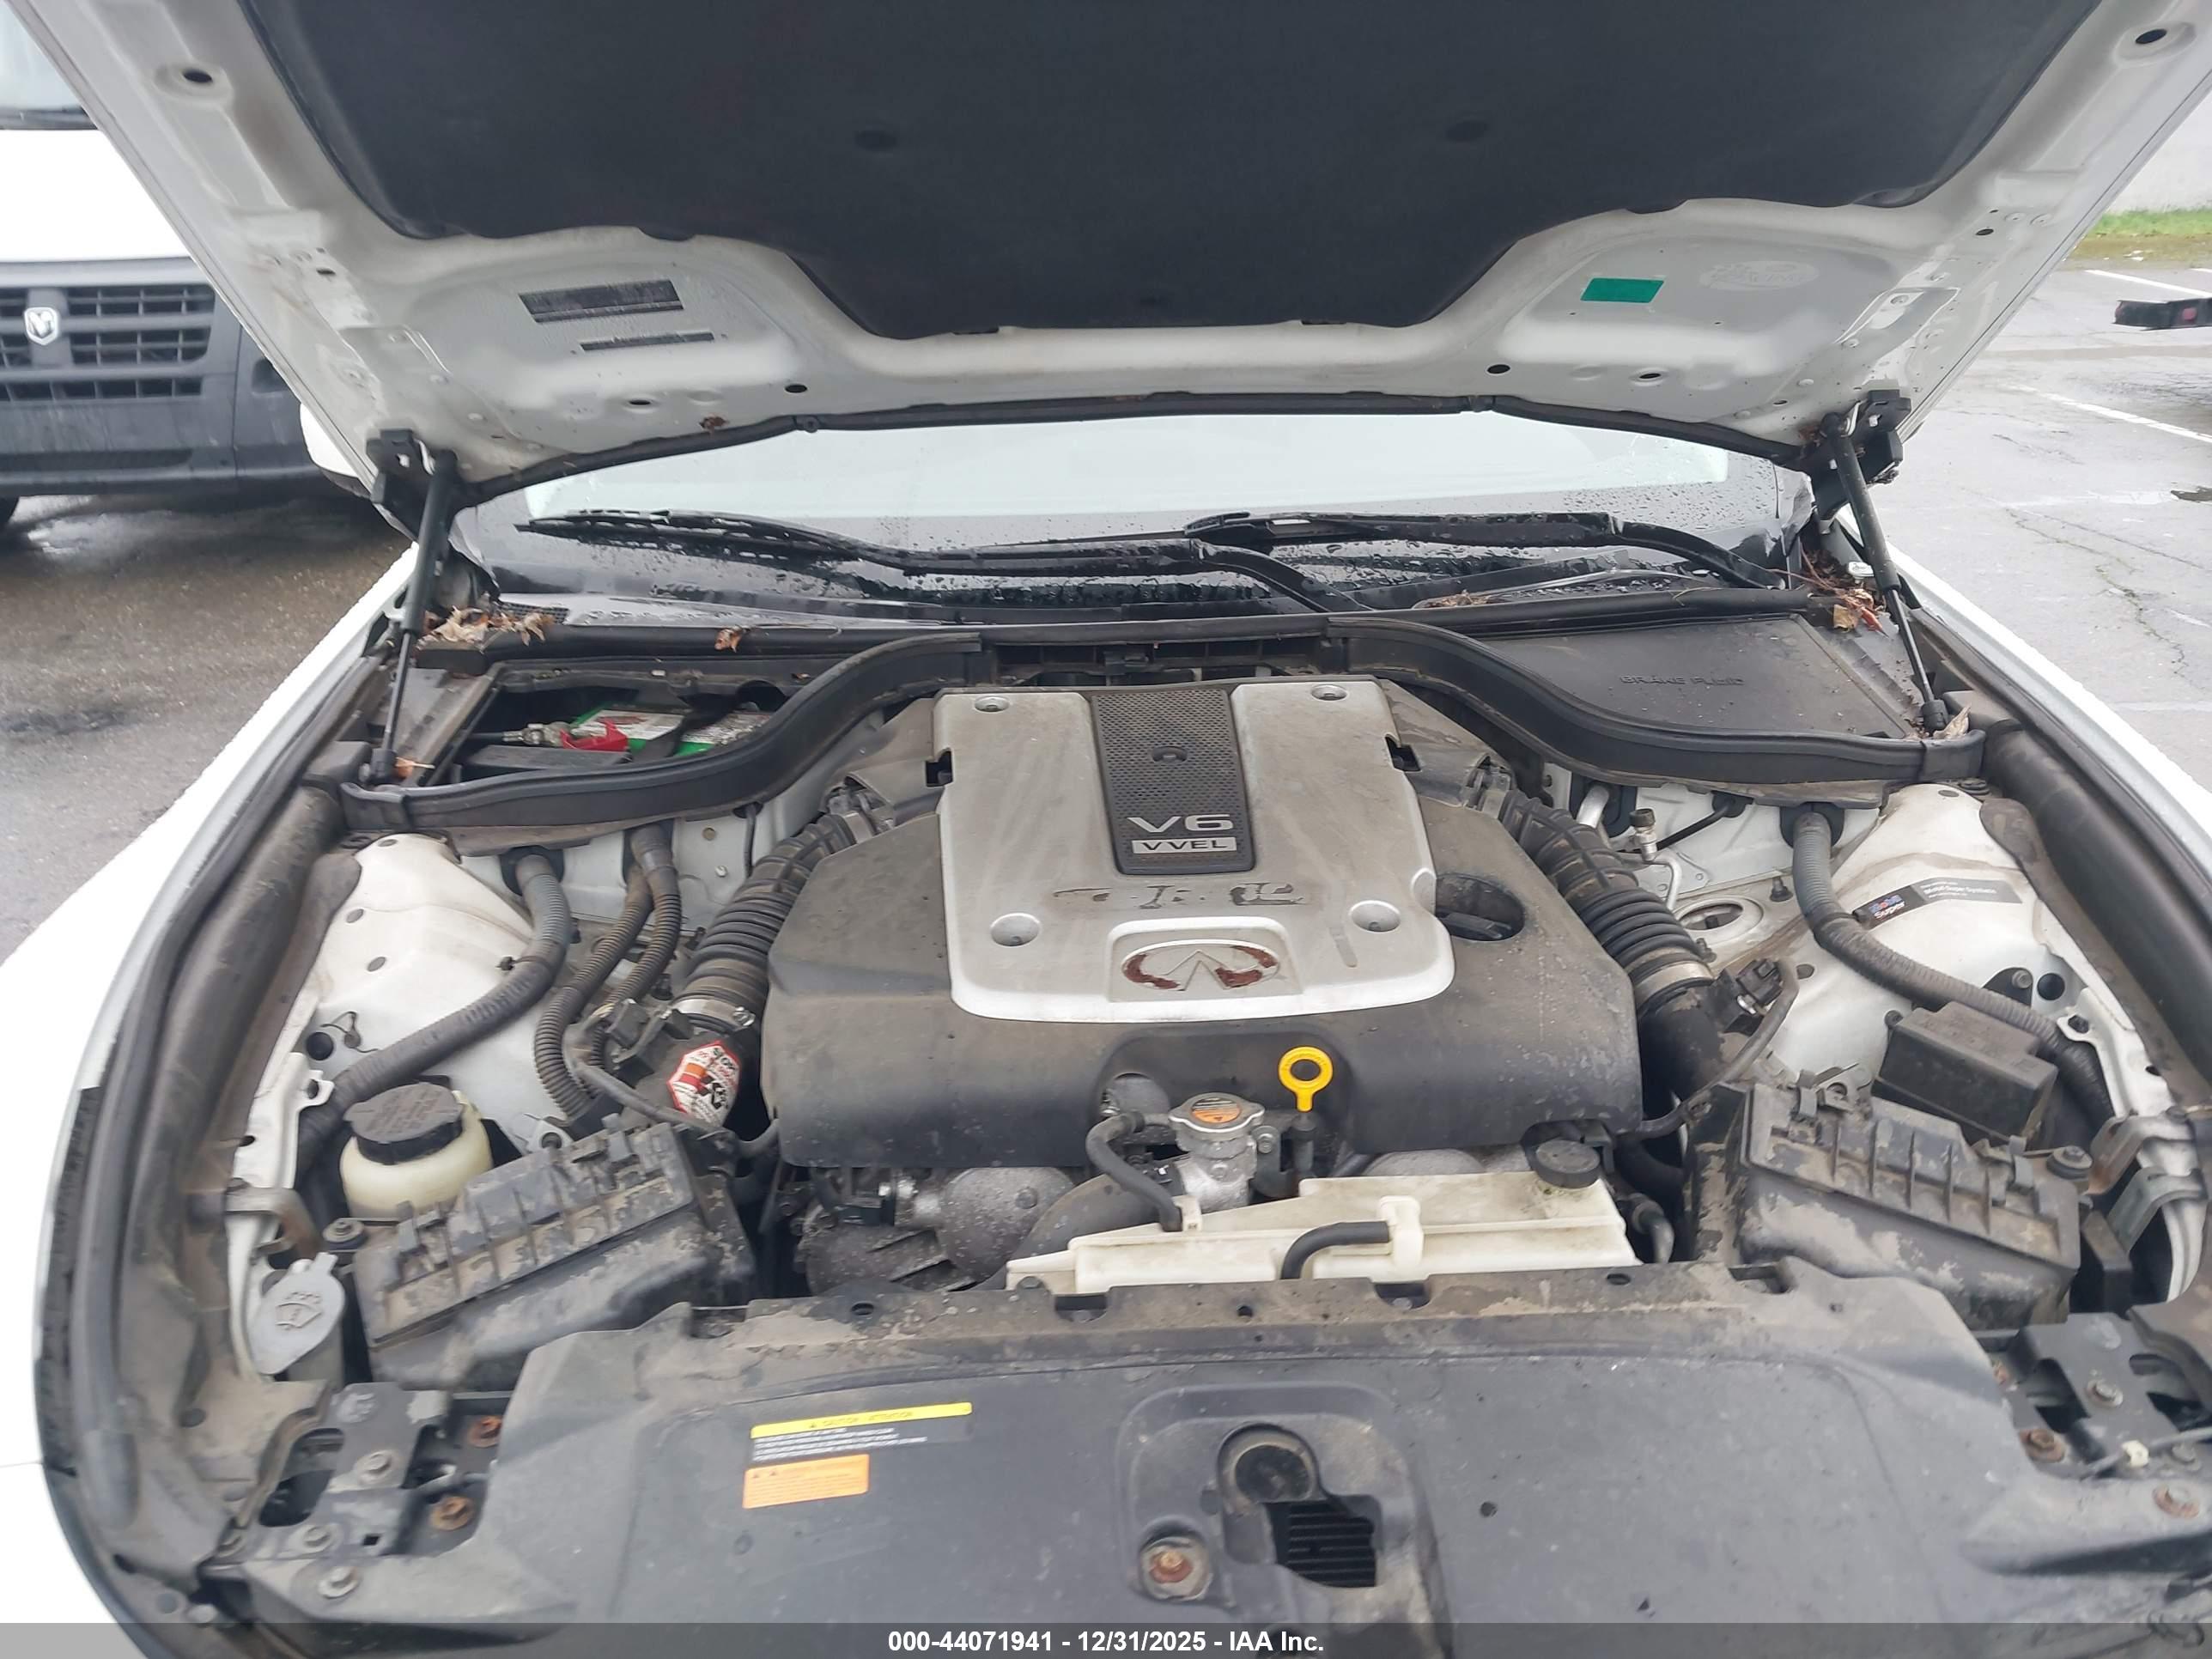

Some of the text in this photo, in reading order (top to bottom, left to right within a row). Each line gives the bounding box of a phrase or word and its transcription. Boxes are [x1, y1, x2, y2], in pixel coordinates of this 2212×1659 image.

[1127, 813, 1234, 833] V6
[1141, 839, 1229, 851] VVEL
[1874, 901, 1905, 919] Super
